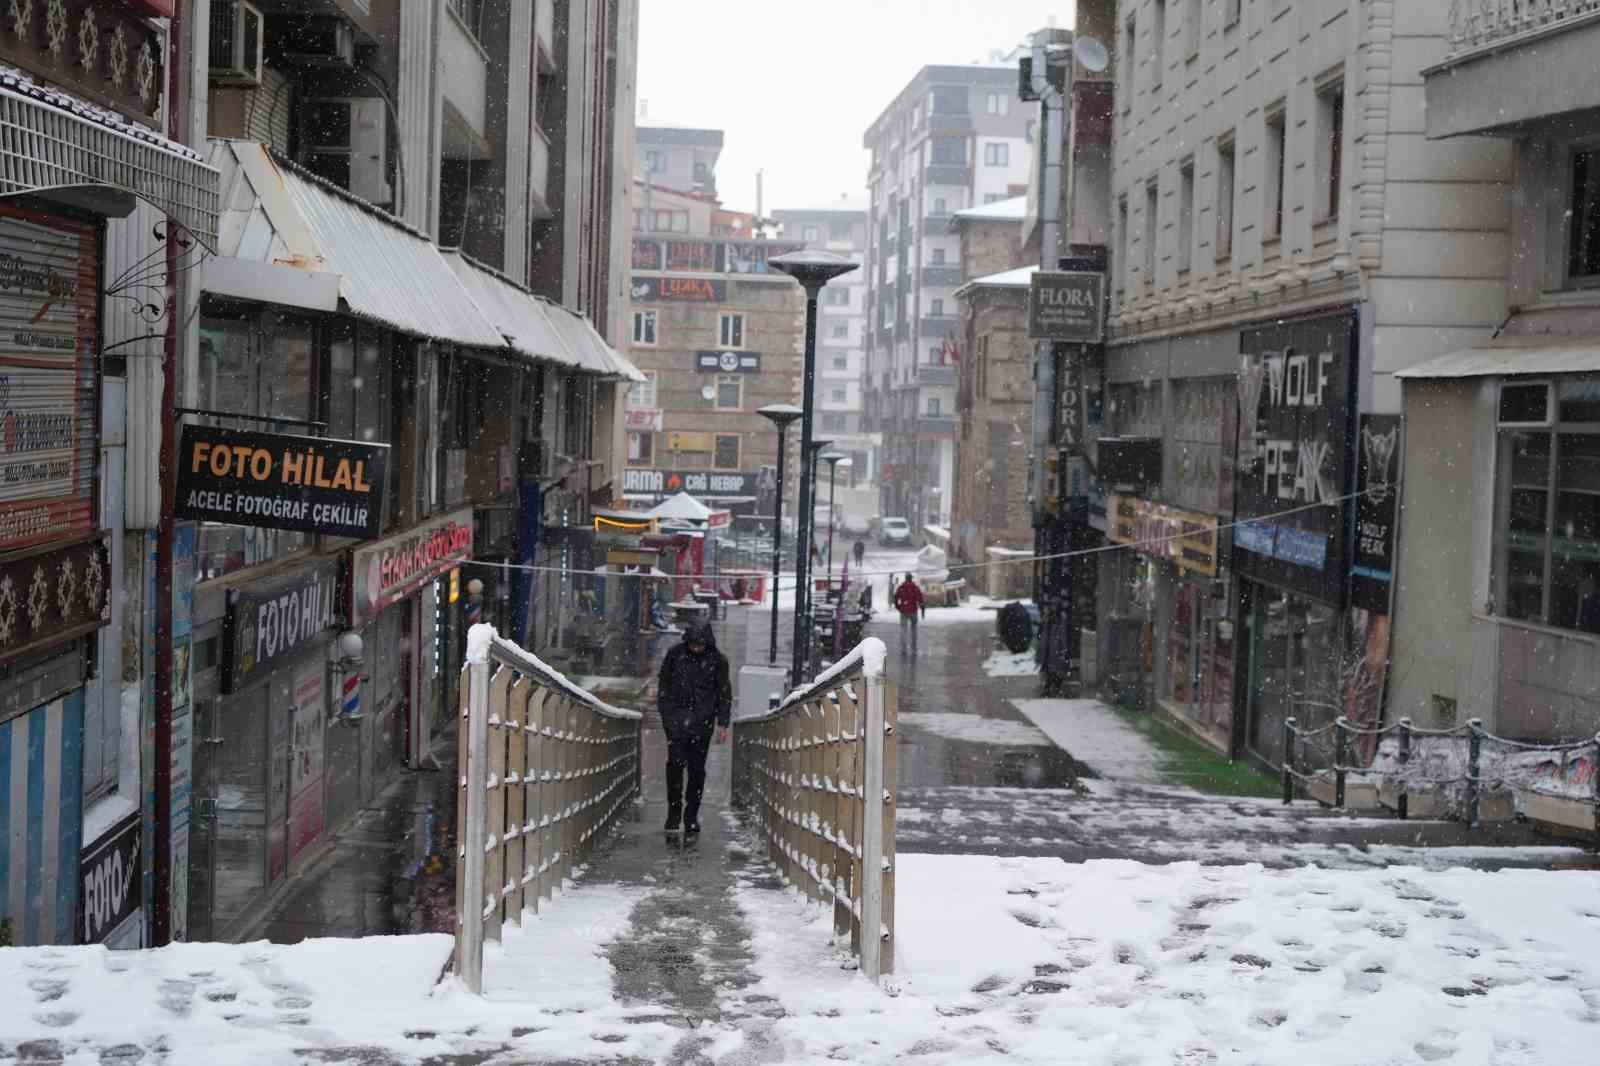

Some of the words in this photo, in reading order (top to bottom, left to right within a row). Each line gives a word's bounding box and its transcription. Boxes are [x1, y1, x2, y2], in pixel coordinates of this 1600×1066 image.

[1040, 287, 1094, 306] FLORA
[1265, 350, 1333, 406] WOLF
[191, 441, 272, 481] FOTO
[280, 446, 371, 493] HİLAL
[188, 489, 232, 512] ACELE
[235, 494, 309, 519] FOTOĞRAF
[312, 499, 368, 528] ÇEKİLİR
[255, 591, 299, 664] FOTO
[84, 850, 123, 943] FOTO
